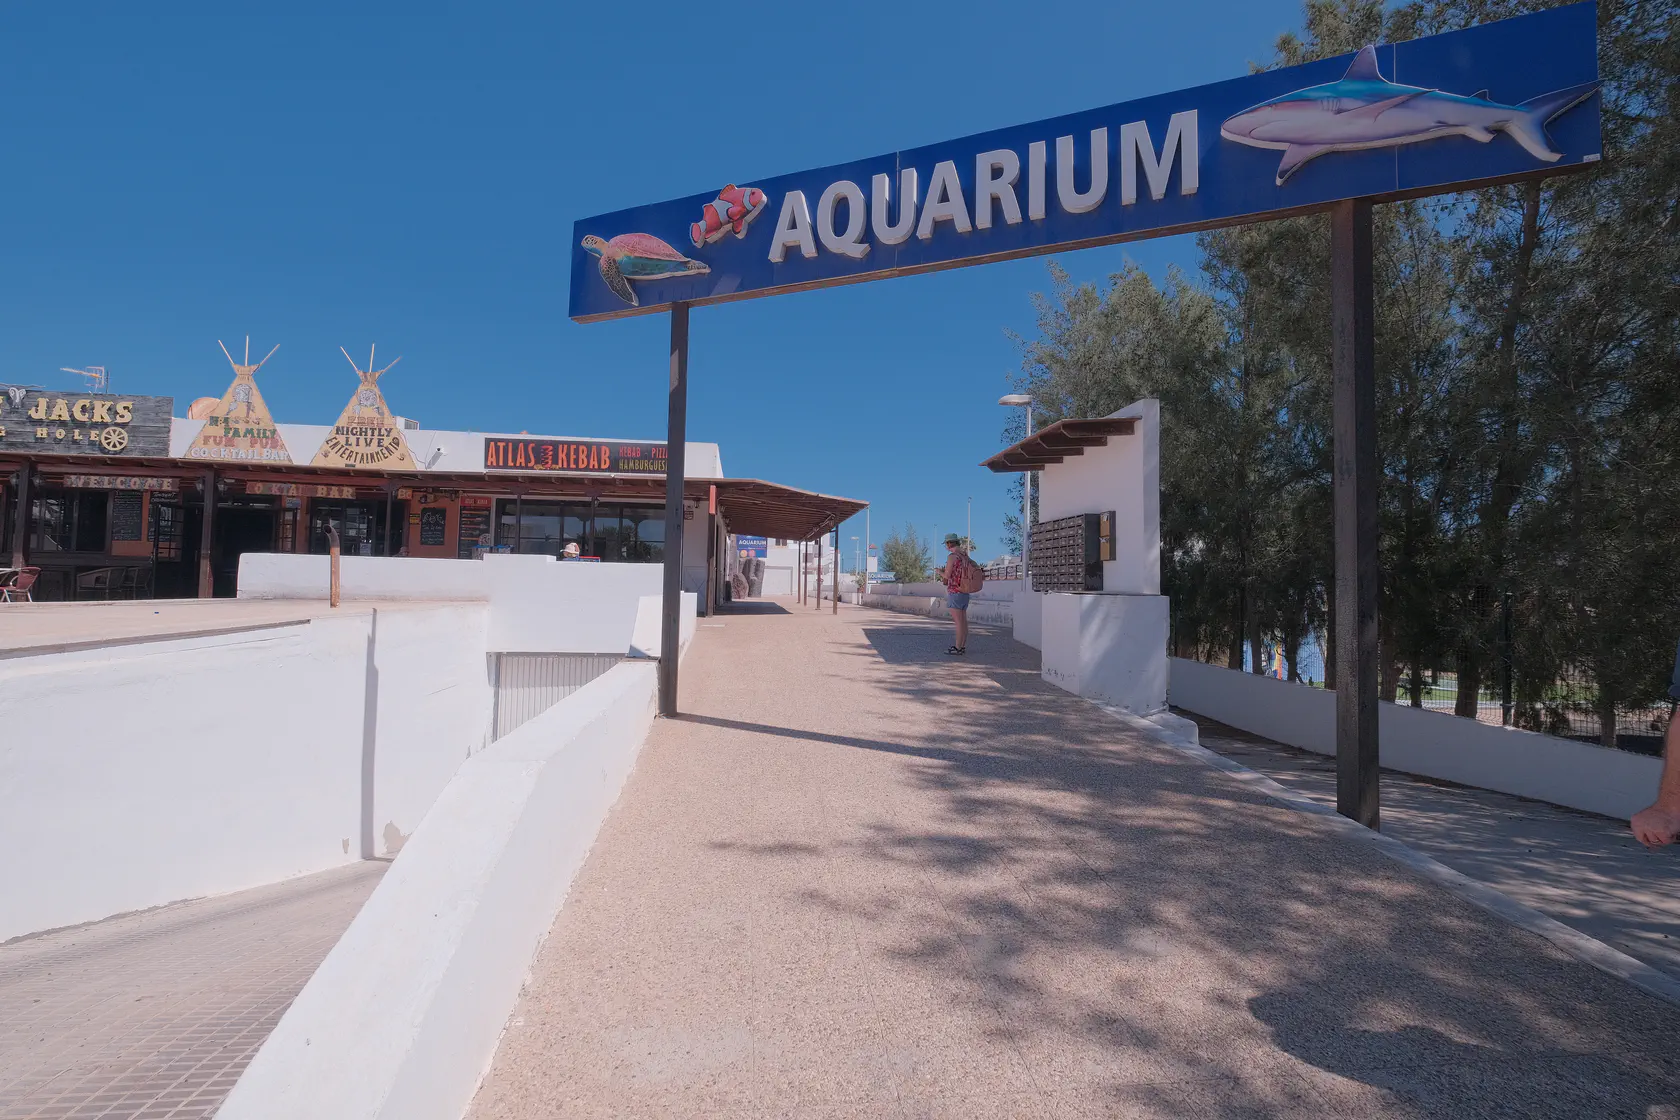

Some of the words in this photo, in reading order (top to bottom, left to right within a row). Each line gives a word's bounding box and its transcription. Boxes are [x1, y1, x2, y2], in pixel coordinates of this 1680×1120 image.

[768, 108, 1199, 263] AQUARIUM
[28, 397, 134, 423] JACKS
[36, 427, 99, 441] HOLE
[224, 427, 277, 438] FAMILY
[335, 426, 394, 437] NIGHTLY
[203, 435, 235, 447] FUN
[345, 436, 384, 447] LIVE
[191, 447, 260, 459] COCKTAIL
[263, 449, 290, 460] BAR
[325, 436, 399, 464] ENTERTAINMENT
[487, 441, 536, 467] ATLAS
[558, 444, 611, 469] KEBAB
[618, 446, 641, 457] KEBAB
[618, 459, 668, 471] HAMBURGUES
[69, 475, 173, 491] WELCOME
[316, 486, 354, 499] BAR
